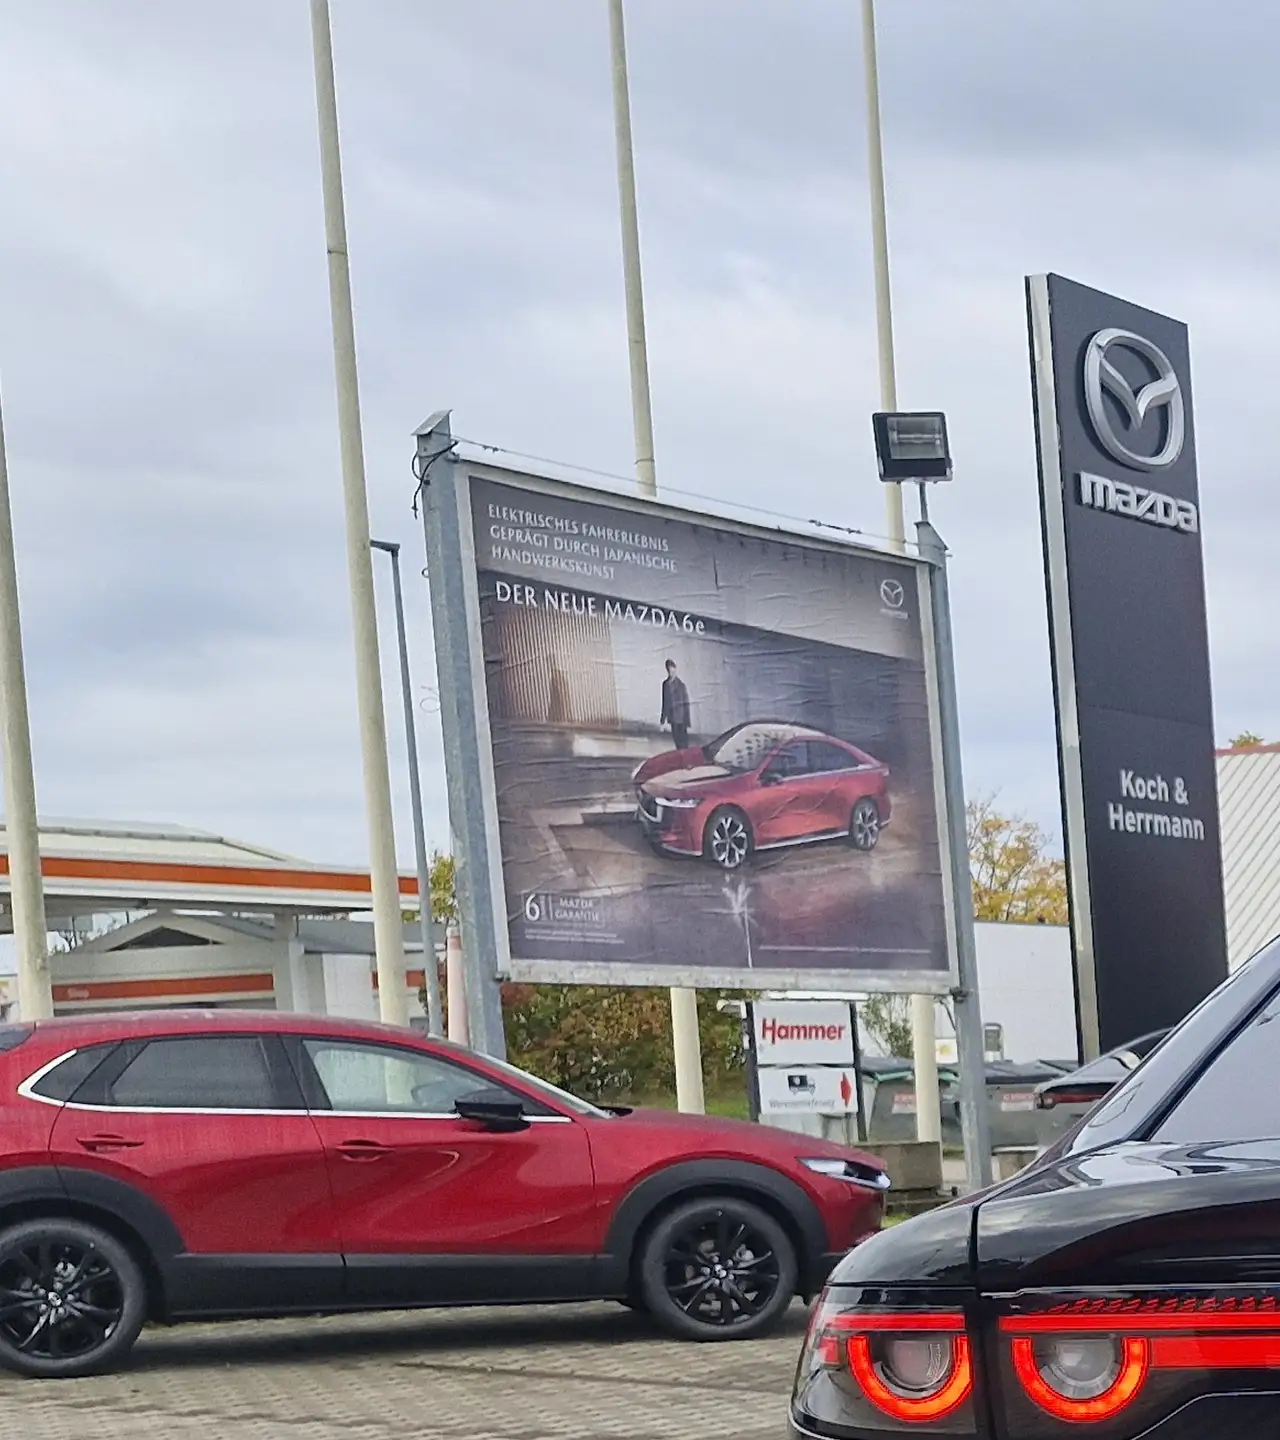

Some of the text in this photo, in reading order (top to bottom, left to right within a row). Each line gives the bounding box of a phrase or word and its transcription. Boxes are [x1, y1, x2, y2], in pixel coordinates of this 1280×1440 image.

[488, 503, 669, 552] ELEKTRISCHES FAHRERLEBNIS
[490, 524, 678, 573] GEPRÄGT DURCH JAPANISCHE
[492, 545, 615, 580] HANDWERKSKUNST
[495, 580, 537, 608] DER
[544, 589, 597, 617] NEUE
[1120, 768, 1190, 806] Koch &
[1107, 800, 1205, 841] Herrmann
[525, 893, 540, 921] 6
[762, 1017, 845, 1045] Hammer
